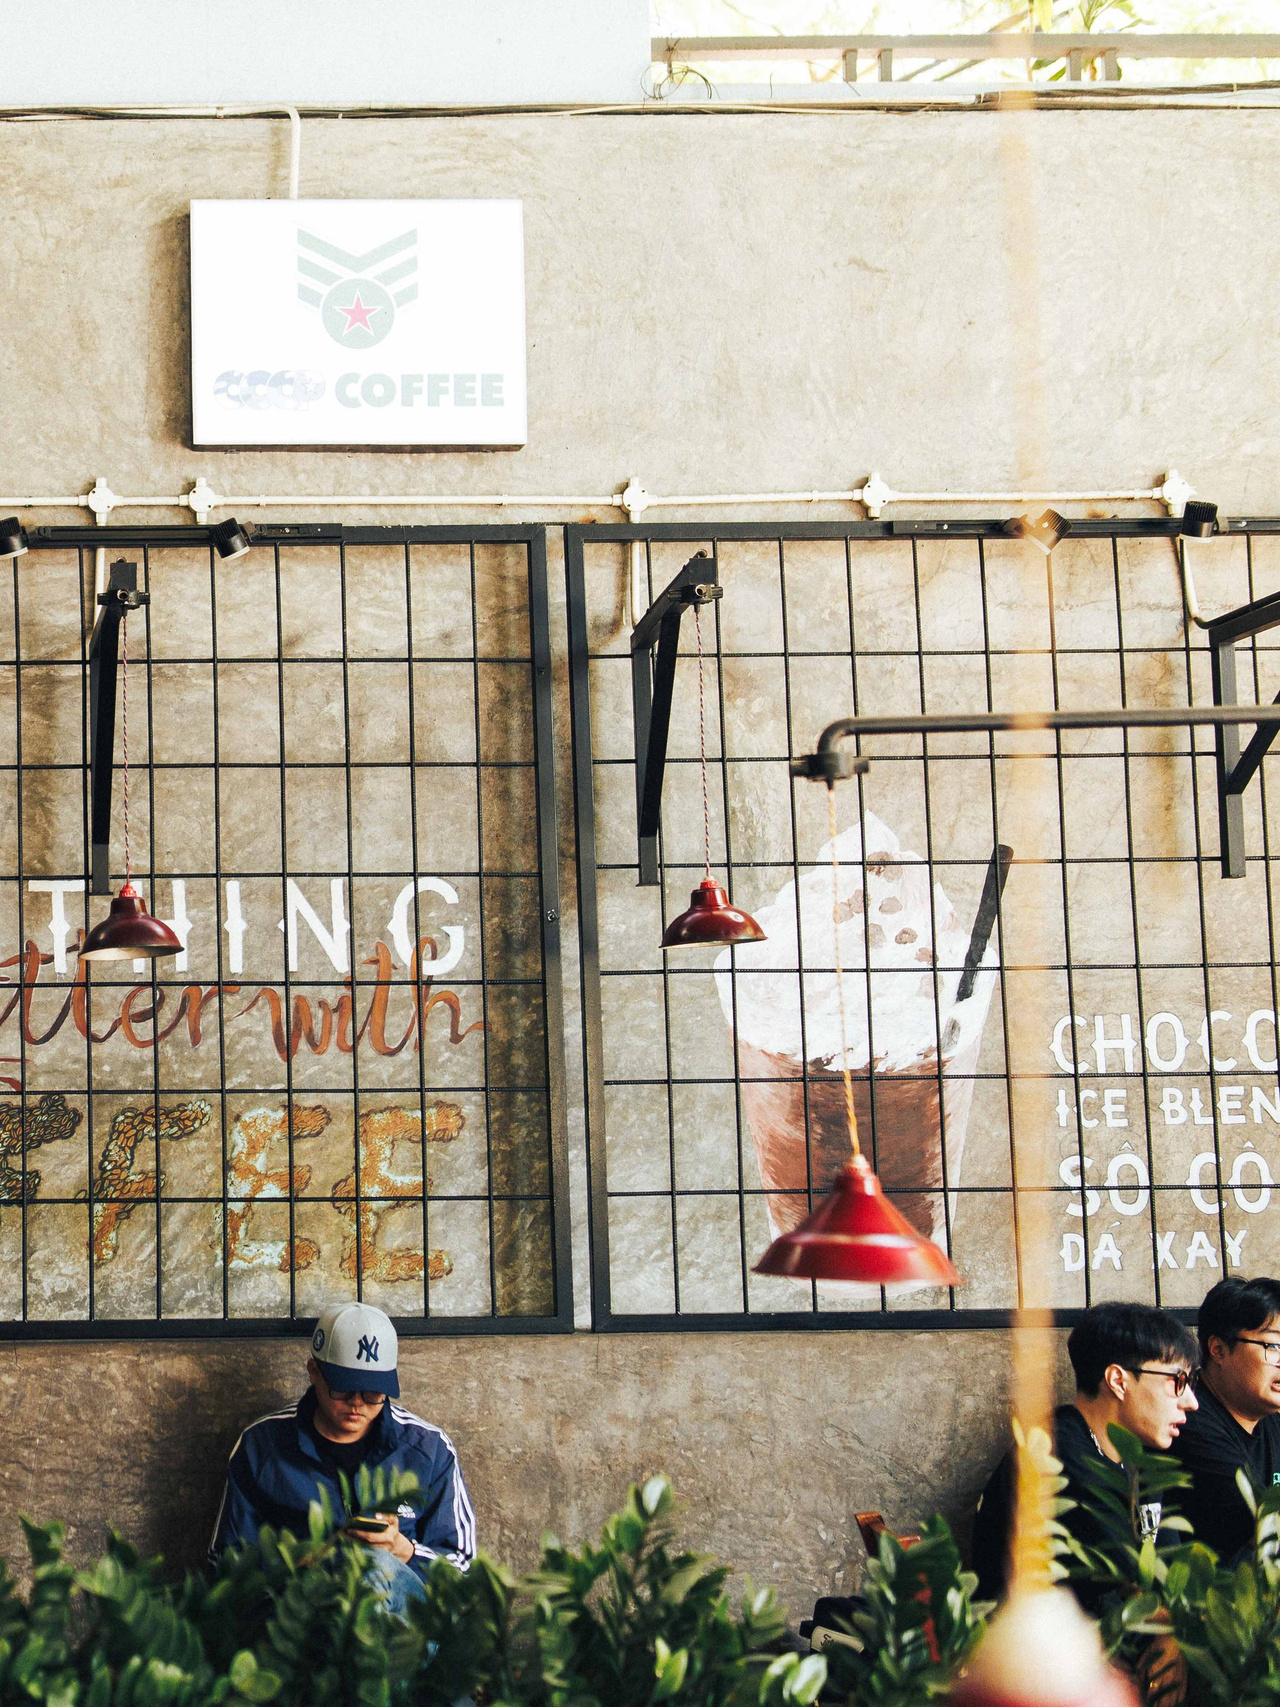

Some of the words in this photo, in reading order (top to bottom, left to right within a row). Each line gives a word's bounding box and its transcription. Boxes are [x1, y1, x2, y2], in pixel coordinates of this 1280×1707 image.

[335, 372, 505, 408] COFFEE
[233, 937, 492, 1062] with
[1055, 1089, 1129, 1128] ICE
[1059, 1141, 1151, 1216] SÔ
[1185, 1140, 1275, 1214] CÔ
[1059, 1221, 1123, 1272] DÁ
[1150, 1229, 1247, 1270] XAY
